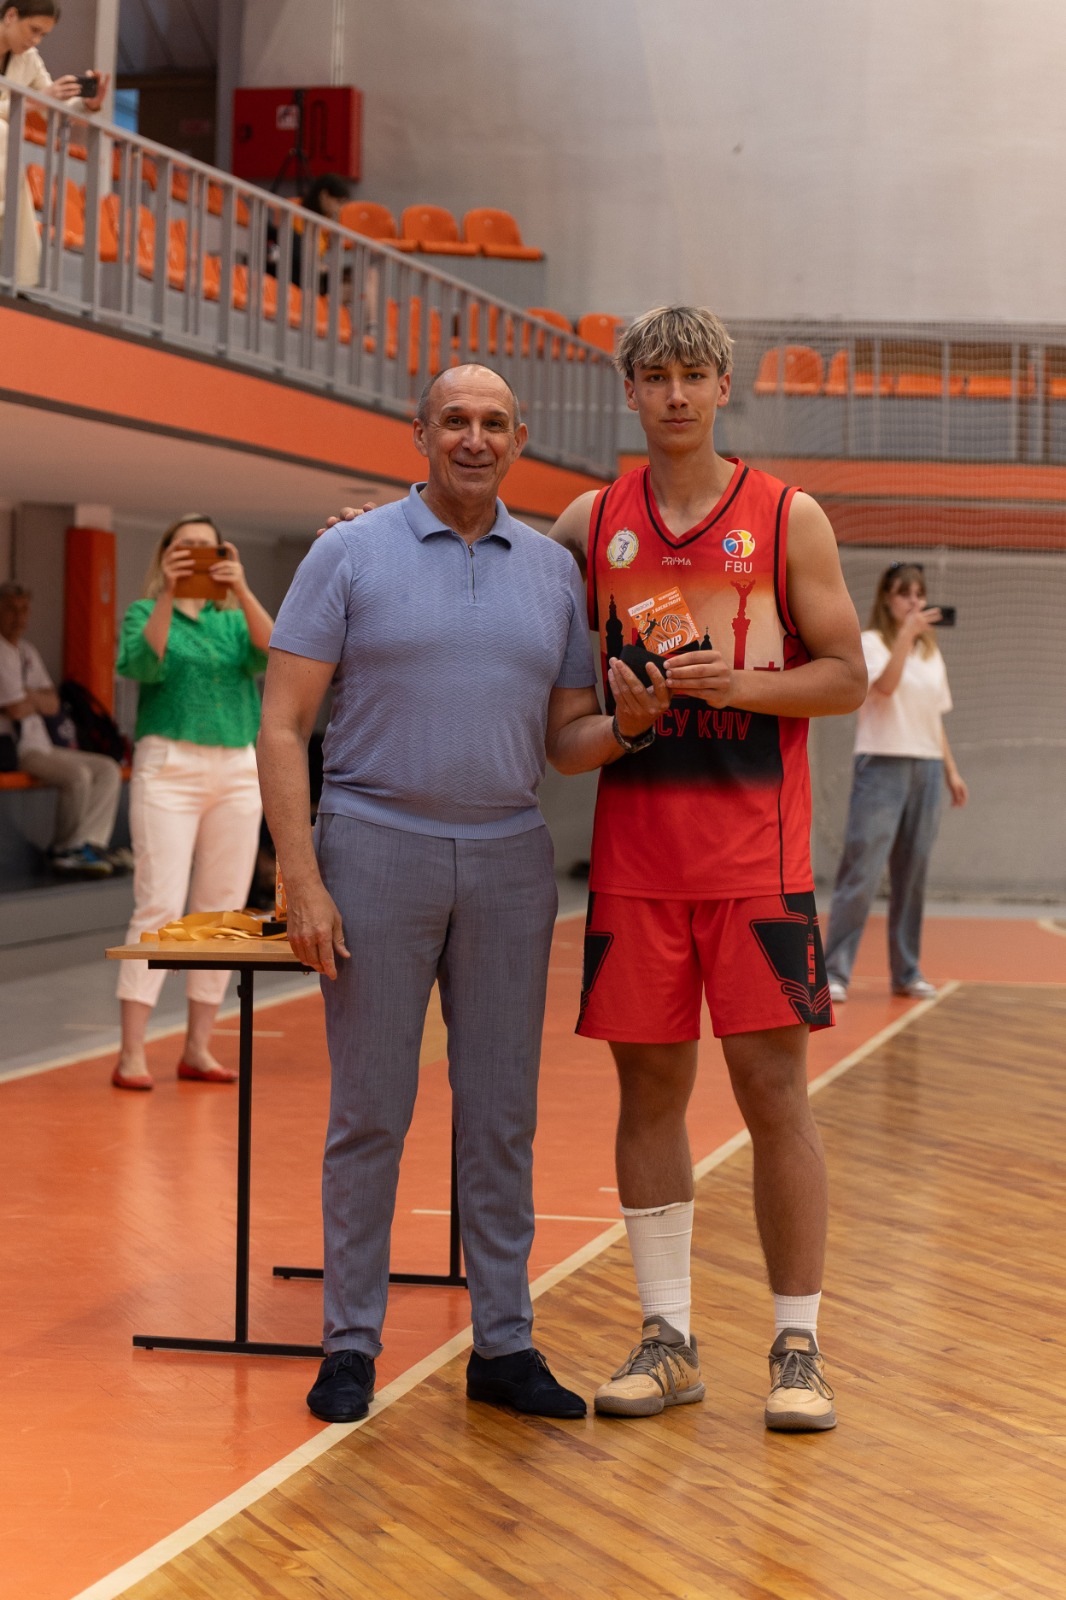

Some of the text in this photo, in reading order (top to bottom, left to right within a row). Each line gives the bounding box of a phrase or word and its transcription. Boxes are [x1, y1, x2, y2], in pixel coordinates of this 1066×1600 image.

[724, 560, 753, 574] FBU
[657, 634, 683, 655] MVP
[655, 708, 752, 741] CY KYIV
